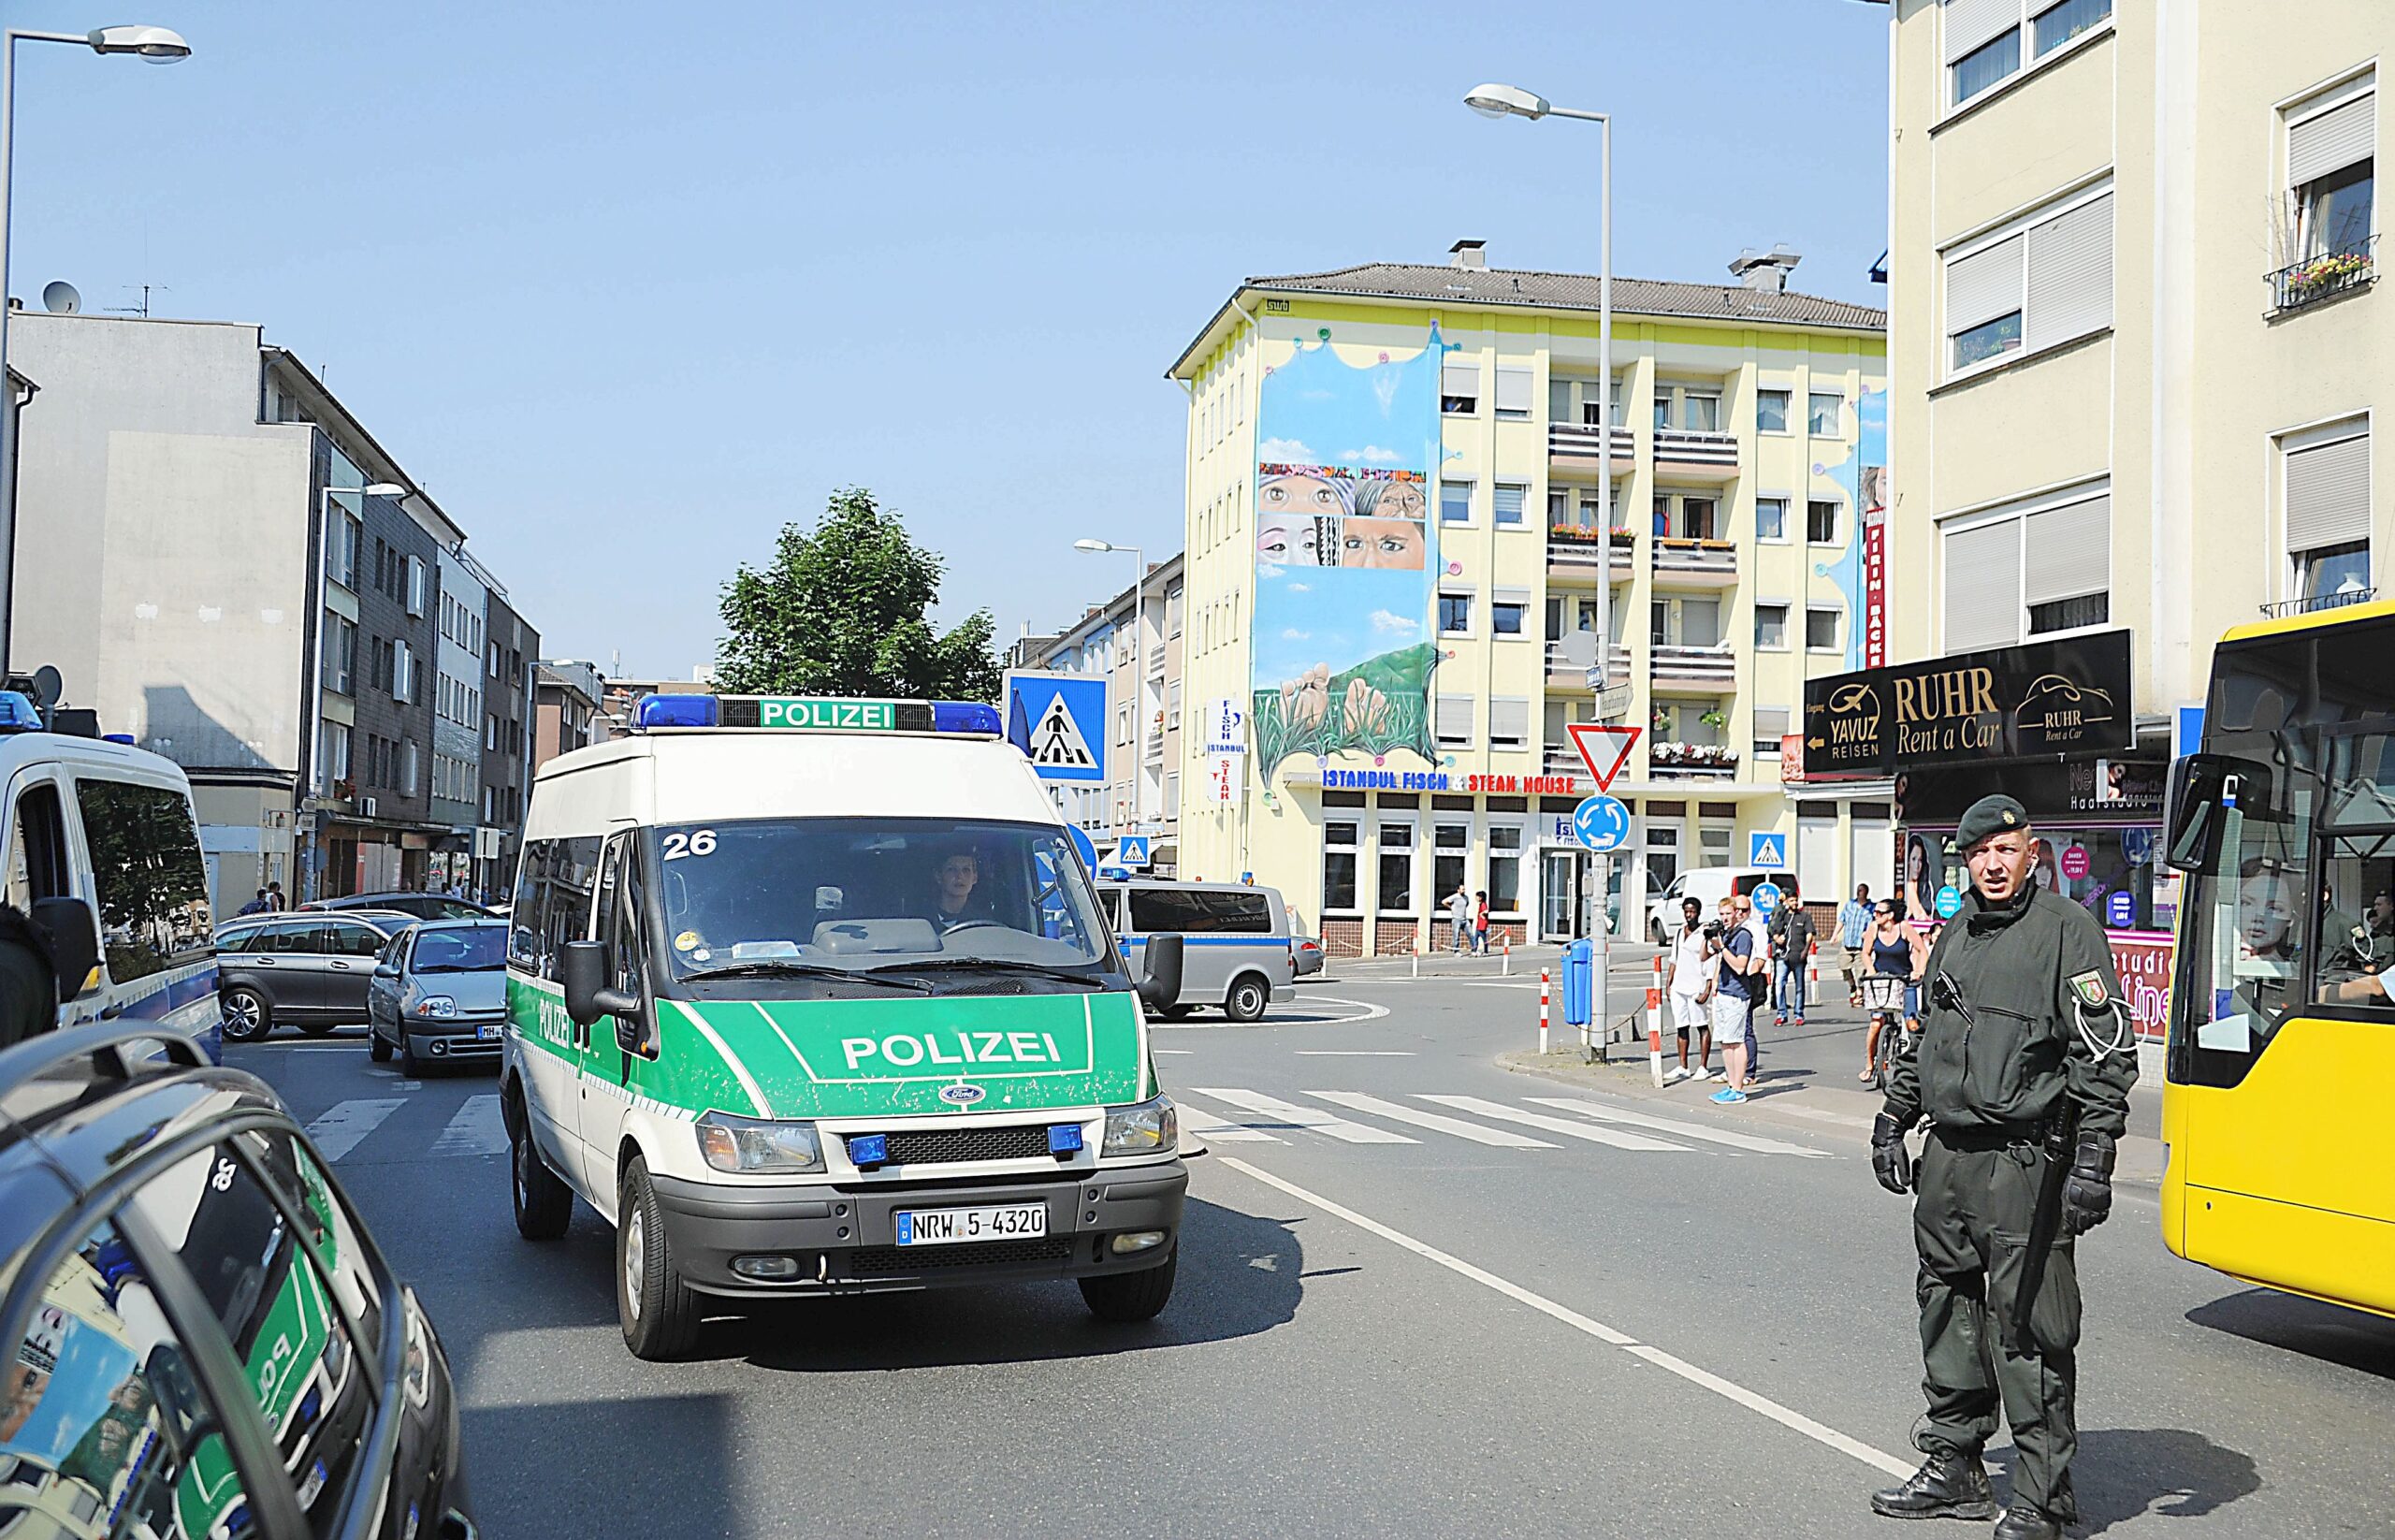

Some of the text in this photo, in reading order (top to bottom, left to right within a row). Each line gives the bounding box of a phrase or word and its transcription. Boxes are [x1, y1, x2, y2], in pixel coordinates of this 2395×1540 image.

[1893, 667, 1999, 723] RUHR
[763, 703, 892, 728] POLIZEI
[1222, 700, 1230, 740] FISCH
[2045, 710, 2082, 728] RUHR
[1830, 716, 1879, 744] YAVUZ
[1897, 716, 1999, 754] Rent a Car
[2045, 728, 2083, 741] Rent a Car
[1208, 744, 1245, 753] ISTANBUL
[1832, 744, 1879, 759] REISEN
[1221, 760, 1229, 800] STEAK
[1322, 769, 1398, 789] ISTANBUL
[1402, 772, 1447, 791] FISCH
[1468, 774, 1516, 792] STEAK
[1523, 776, 1575, 793] HOUSE
[663, 830, 717, 861] 26
[483, 1027, 495, 1037] MH
[540, 999, 569, 1049] POLIZEI
[841, 1032, 1061, 1069] POLIZEI
[951, 1089, 976, 1099] Ford
[913, 1210, 1042, 1240] NRW 5-4320
